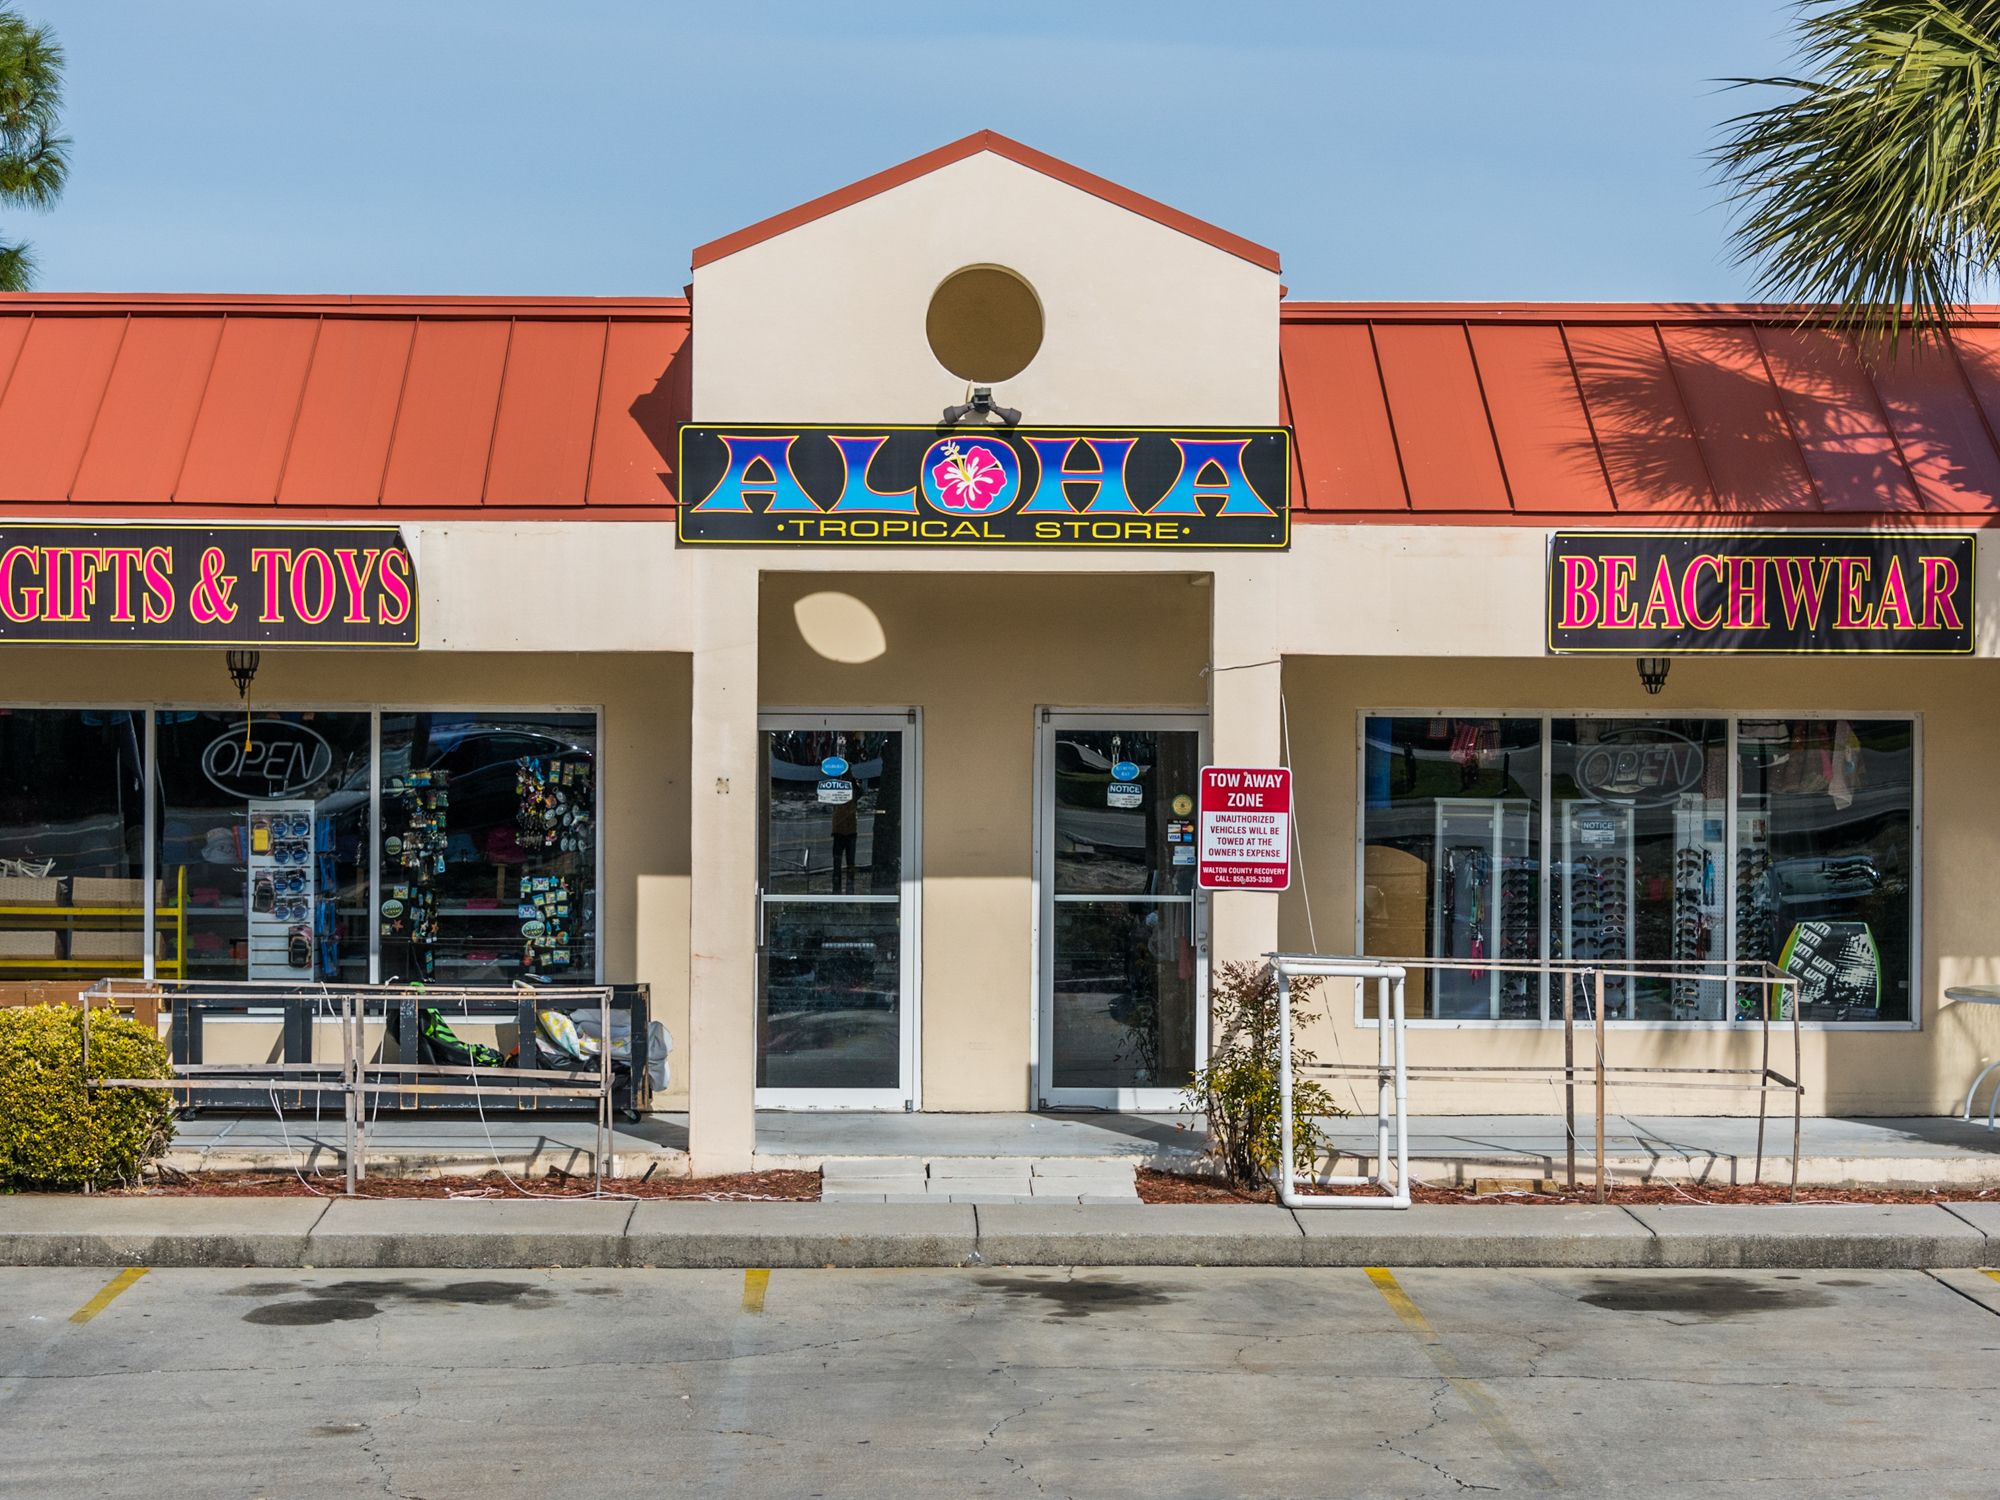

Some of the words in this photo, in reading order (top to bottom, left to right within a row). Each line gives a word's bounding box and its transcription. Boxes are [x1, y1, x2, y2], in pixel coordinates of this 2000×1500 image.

[690, 434, 1279, 517] ALOHA
[788, 519, 1005, 538] TROPICAL
[1035, 521, 1180, 540] STORE
[0, 545, 176, 624] GIFTS
[190, 546, 239, 625] &
[252, 547, 412, 625] TOYS
[1558, 554, 1964, 631] BEACHWEAR
[210, 740, 321, 779] OPEN
[1585, 749, 1693, 787] OPEN
[820, 781, 850, 789] NOTICE
[1209, 773, 1240, 787] TOW
[1243, 773, 1283, 788] AWAY
[1110, 784, 1140, 793] NOTICE
[1227, 793, 1264, 807] ZONE
[1215, 815, 1275, 824] UNAUTHORIZED
[1583, 821, 1614, 829] NOTICE
[1210, 826, 1247, 834] VEHICLES
[1248, 827, 1267, 835] WILL
[1269, 827, 1280, 835] BE
[1217, 837, 1245, 846] TOWED
[1246, 838, 1256, 846] AT
[1258, 838, 1272, 846] THE
[1208, 848, 1245, 857] OWNER'S
[1246, 849, 1281, 857] EXPENSE
[1202, 866, 1228, 874] WALTON
[1253, 867, 1286, 875] RECOVERY
